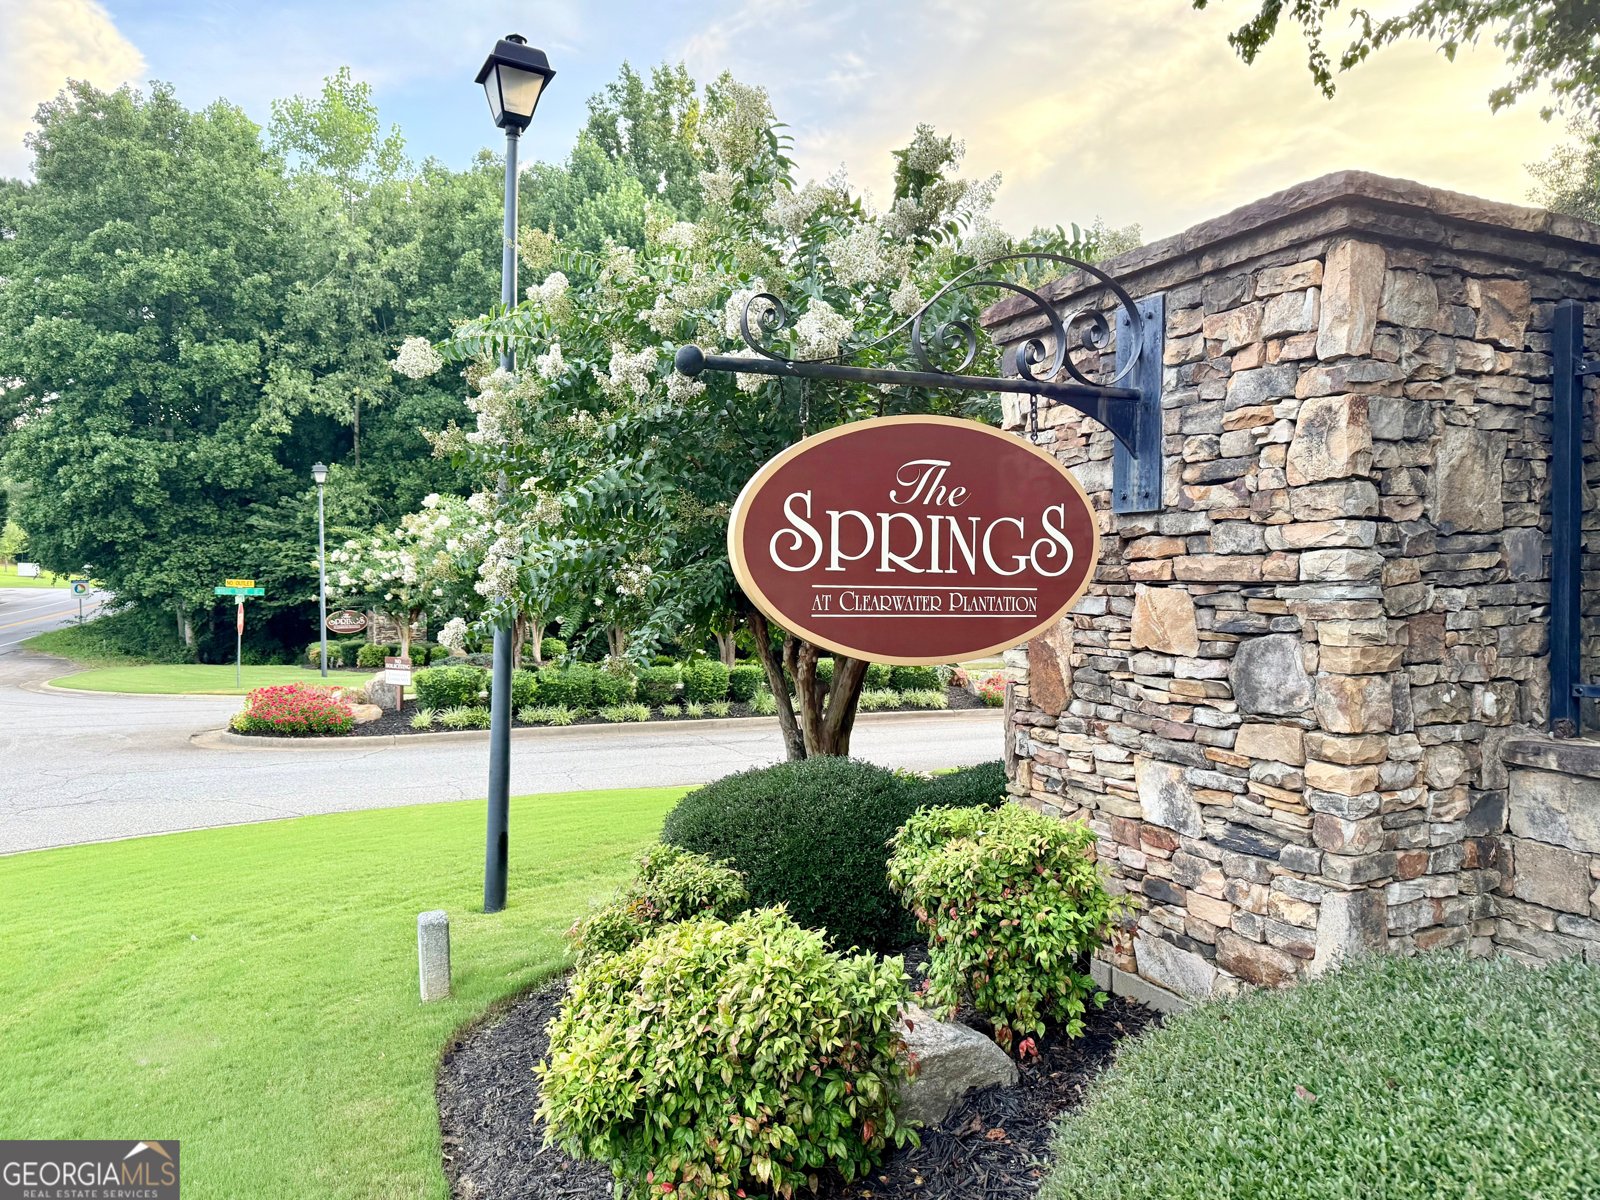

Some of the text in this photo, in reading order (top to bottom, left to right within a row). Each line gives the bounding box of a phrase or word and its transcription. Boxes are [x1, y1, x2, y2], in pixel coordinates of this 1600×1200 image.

[889, 458, 971, 507] The
[769, 489, 1074, 577] SPRINGS
[811, 591, 1038, 612] AT CLEARWATER PLANTATION
